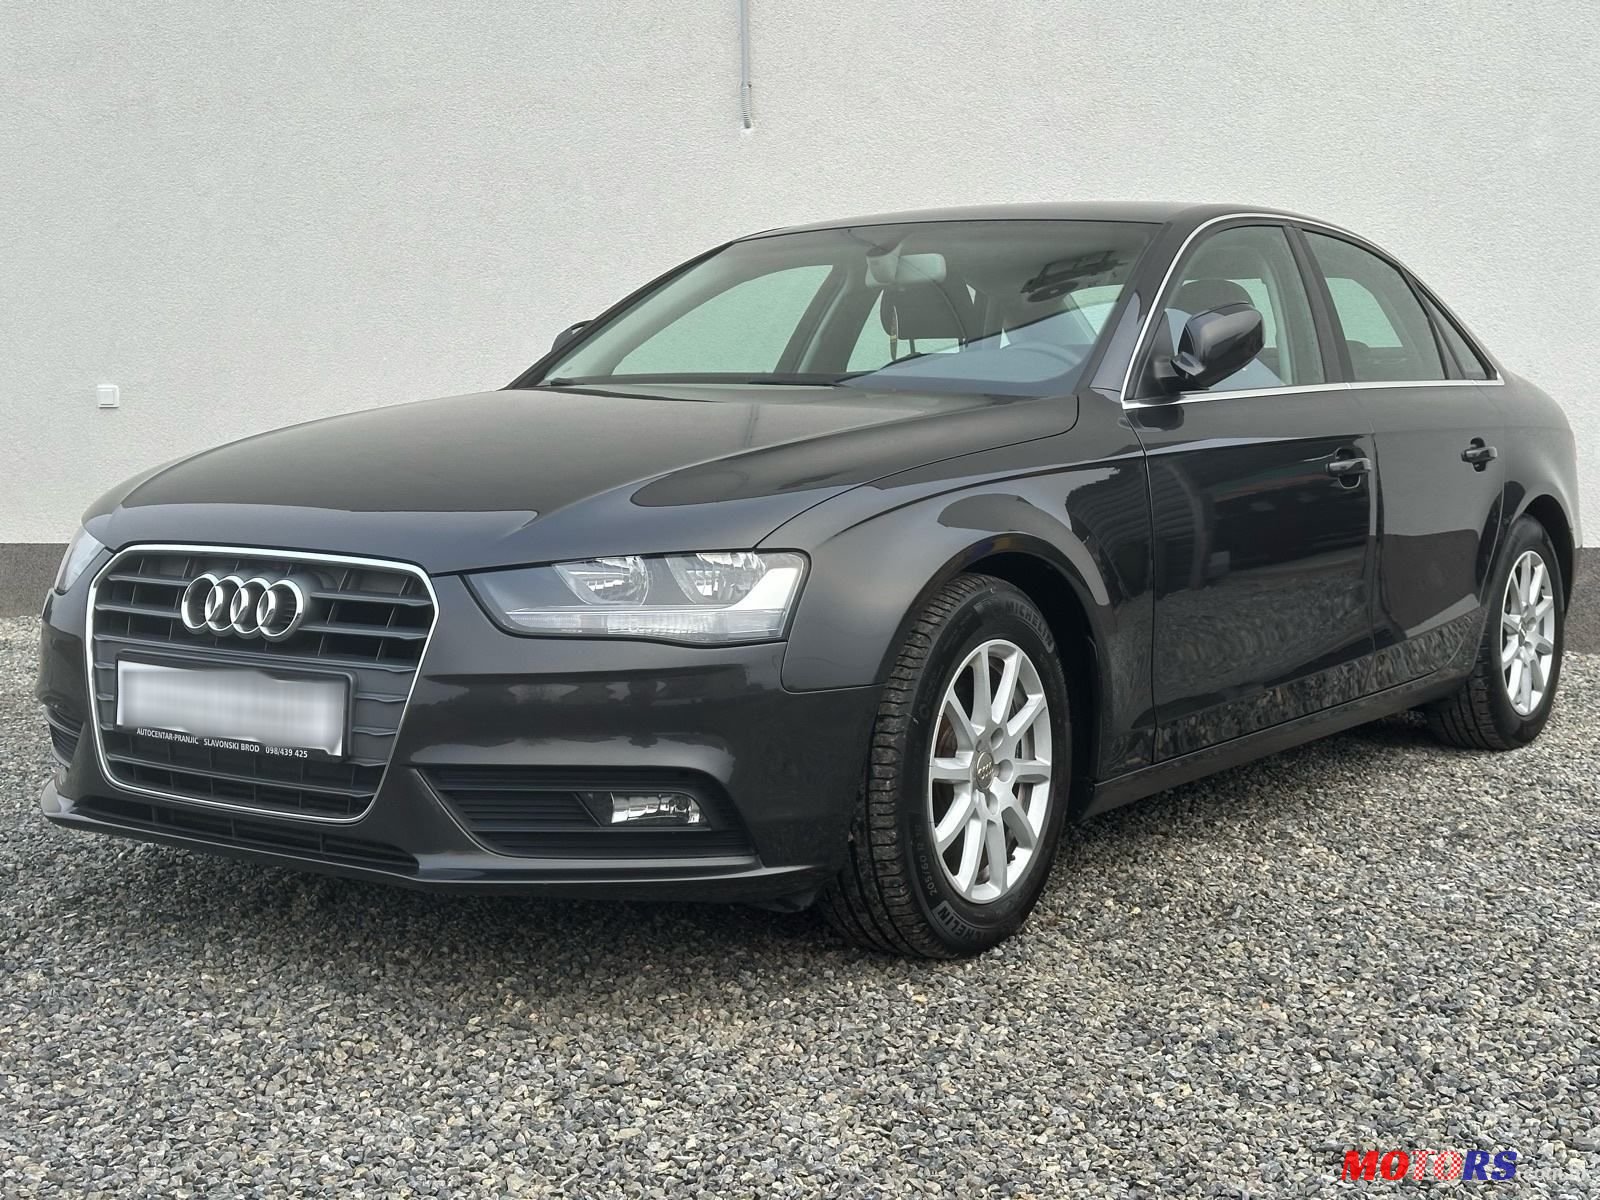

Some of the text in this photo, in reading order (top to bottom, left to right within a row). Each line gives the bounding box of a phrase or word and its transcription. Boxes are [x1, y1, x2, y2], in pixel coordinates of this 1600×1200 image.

[136, 727, 308, 758] AUTOCENTAR-PRANJIC SLAVONSKI BROD 098/439 425
